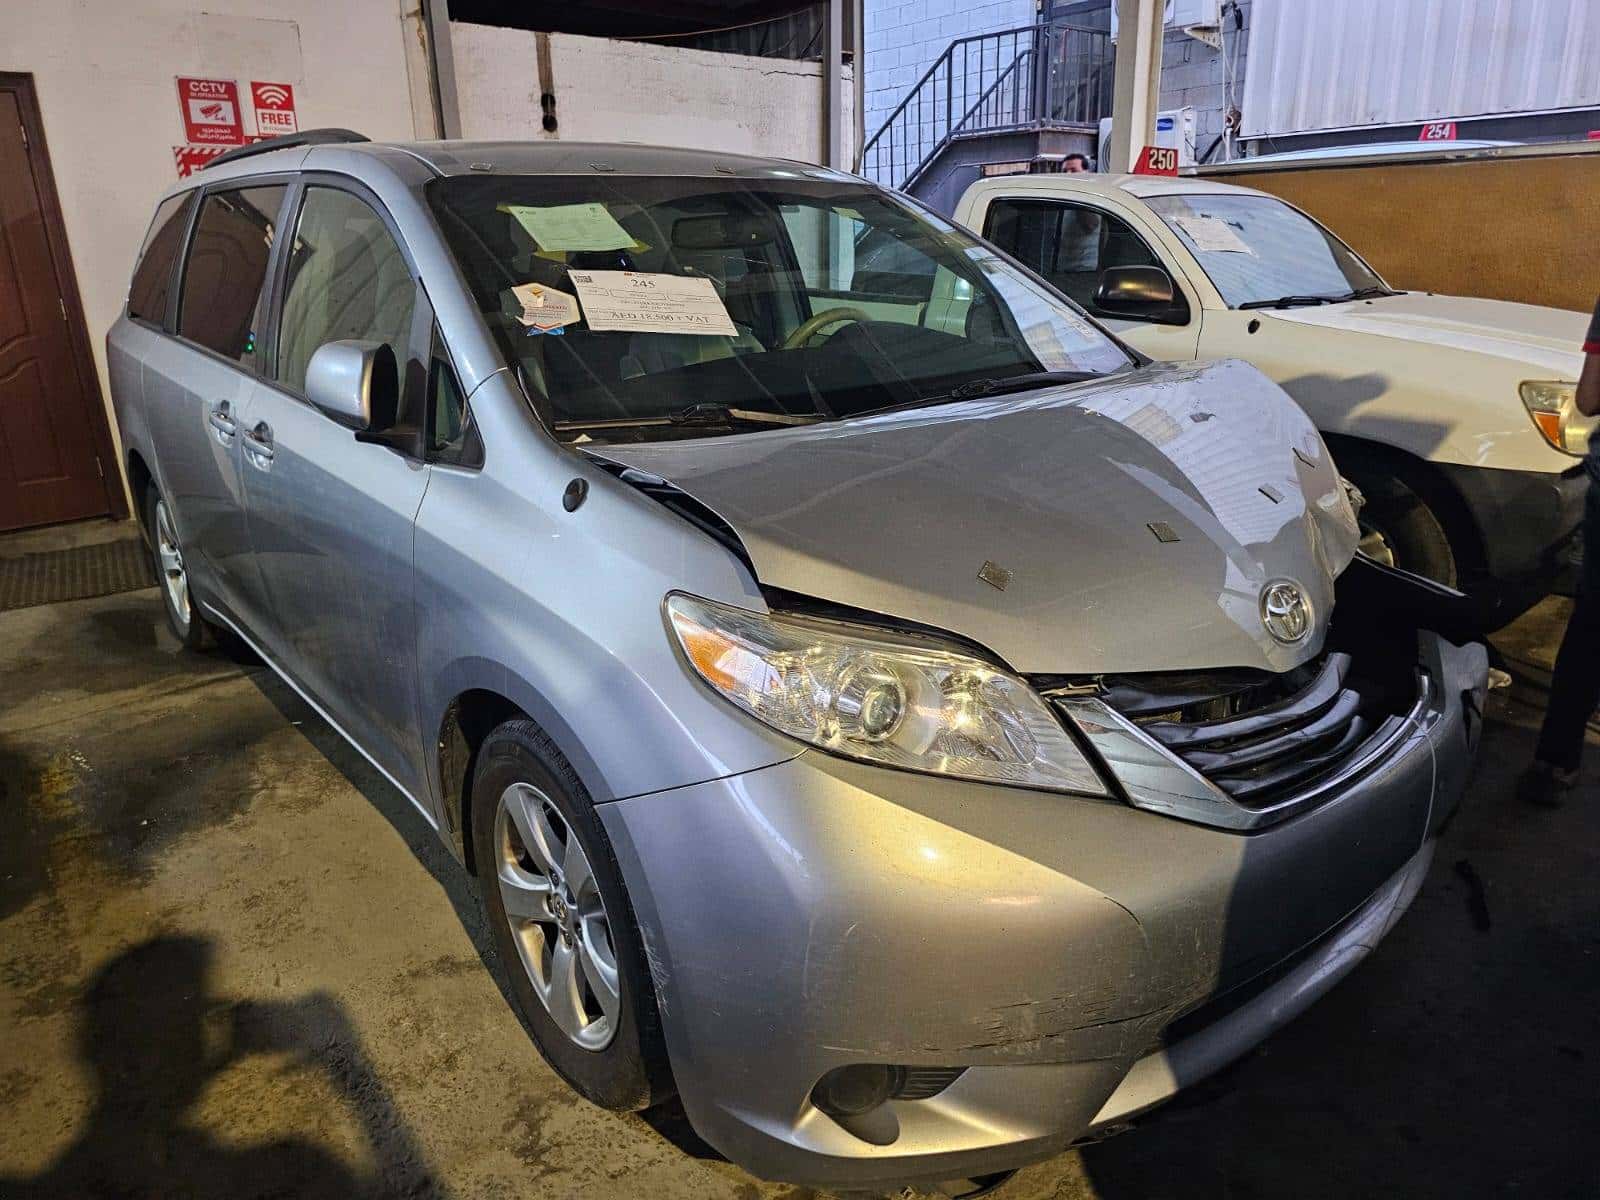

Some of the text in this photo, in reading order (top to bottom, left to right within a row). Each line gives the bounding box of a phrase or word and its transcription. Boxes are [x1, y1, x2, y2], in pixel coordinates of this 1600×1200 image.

[189, 81, 226, 93] CCTV
[261, 112, 292, 126] FREE
[1427, 123, 1450, 139] 254
[1148, 149, 1175, 170] 250
[630, 279, 656, 288] 245
[611, 311, 637, 320] AED
[684, 315, 710, 323] VAT
